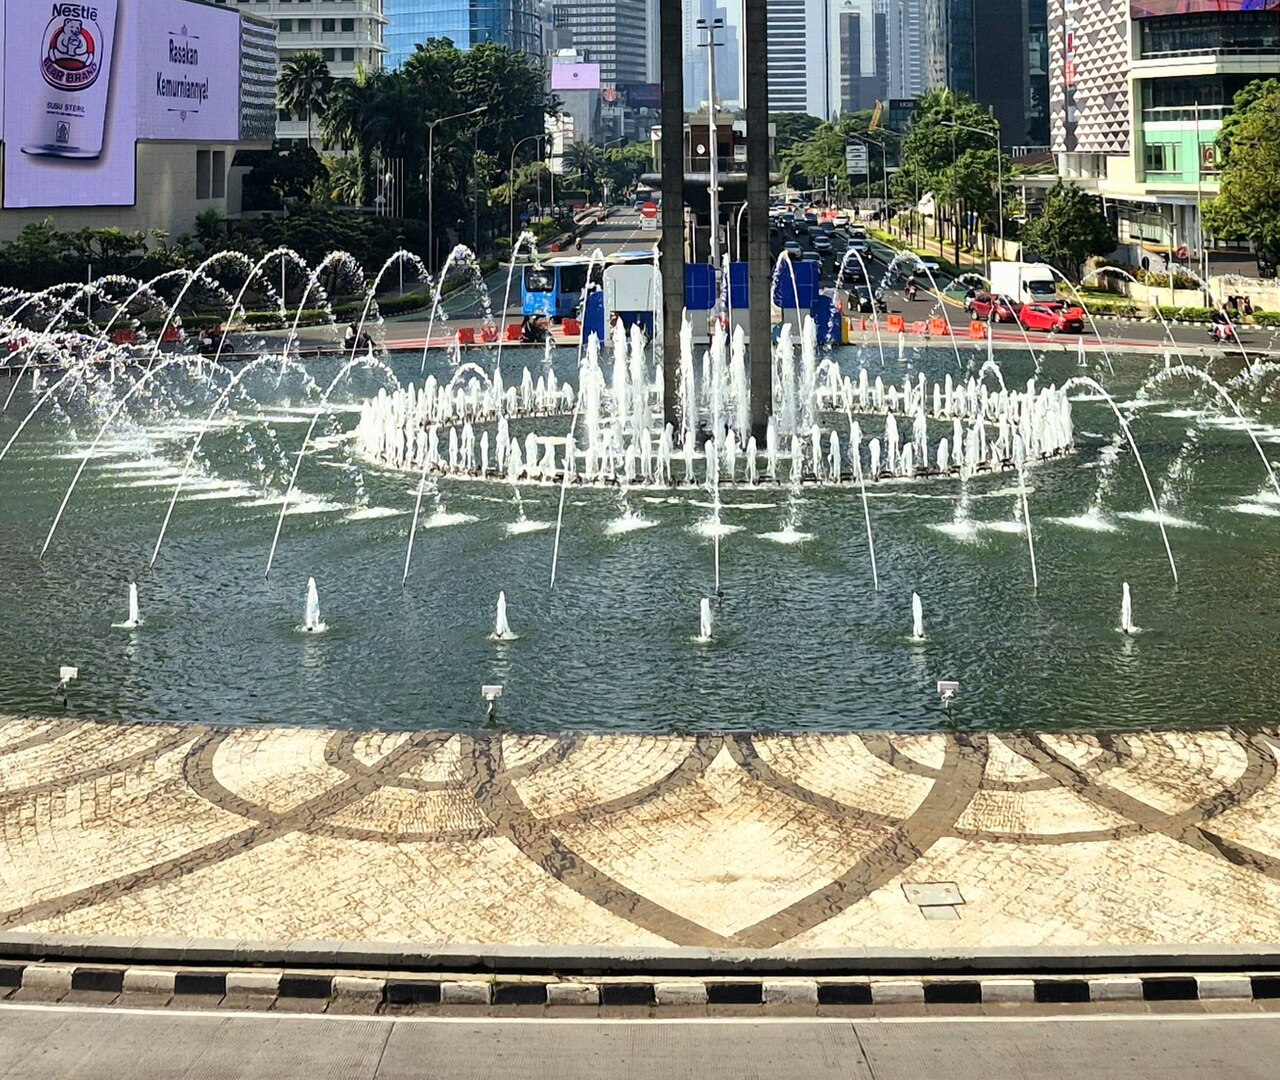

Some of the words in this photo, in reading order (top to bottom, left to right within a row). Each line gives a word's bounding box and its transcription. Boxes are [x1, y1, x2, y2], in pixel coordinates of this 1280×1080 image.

[169, 38, 198, 65] Rasakan
[65, 63, 98, 83] BRAND
[156, 71, 209, 105] Kemurniannya!
